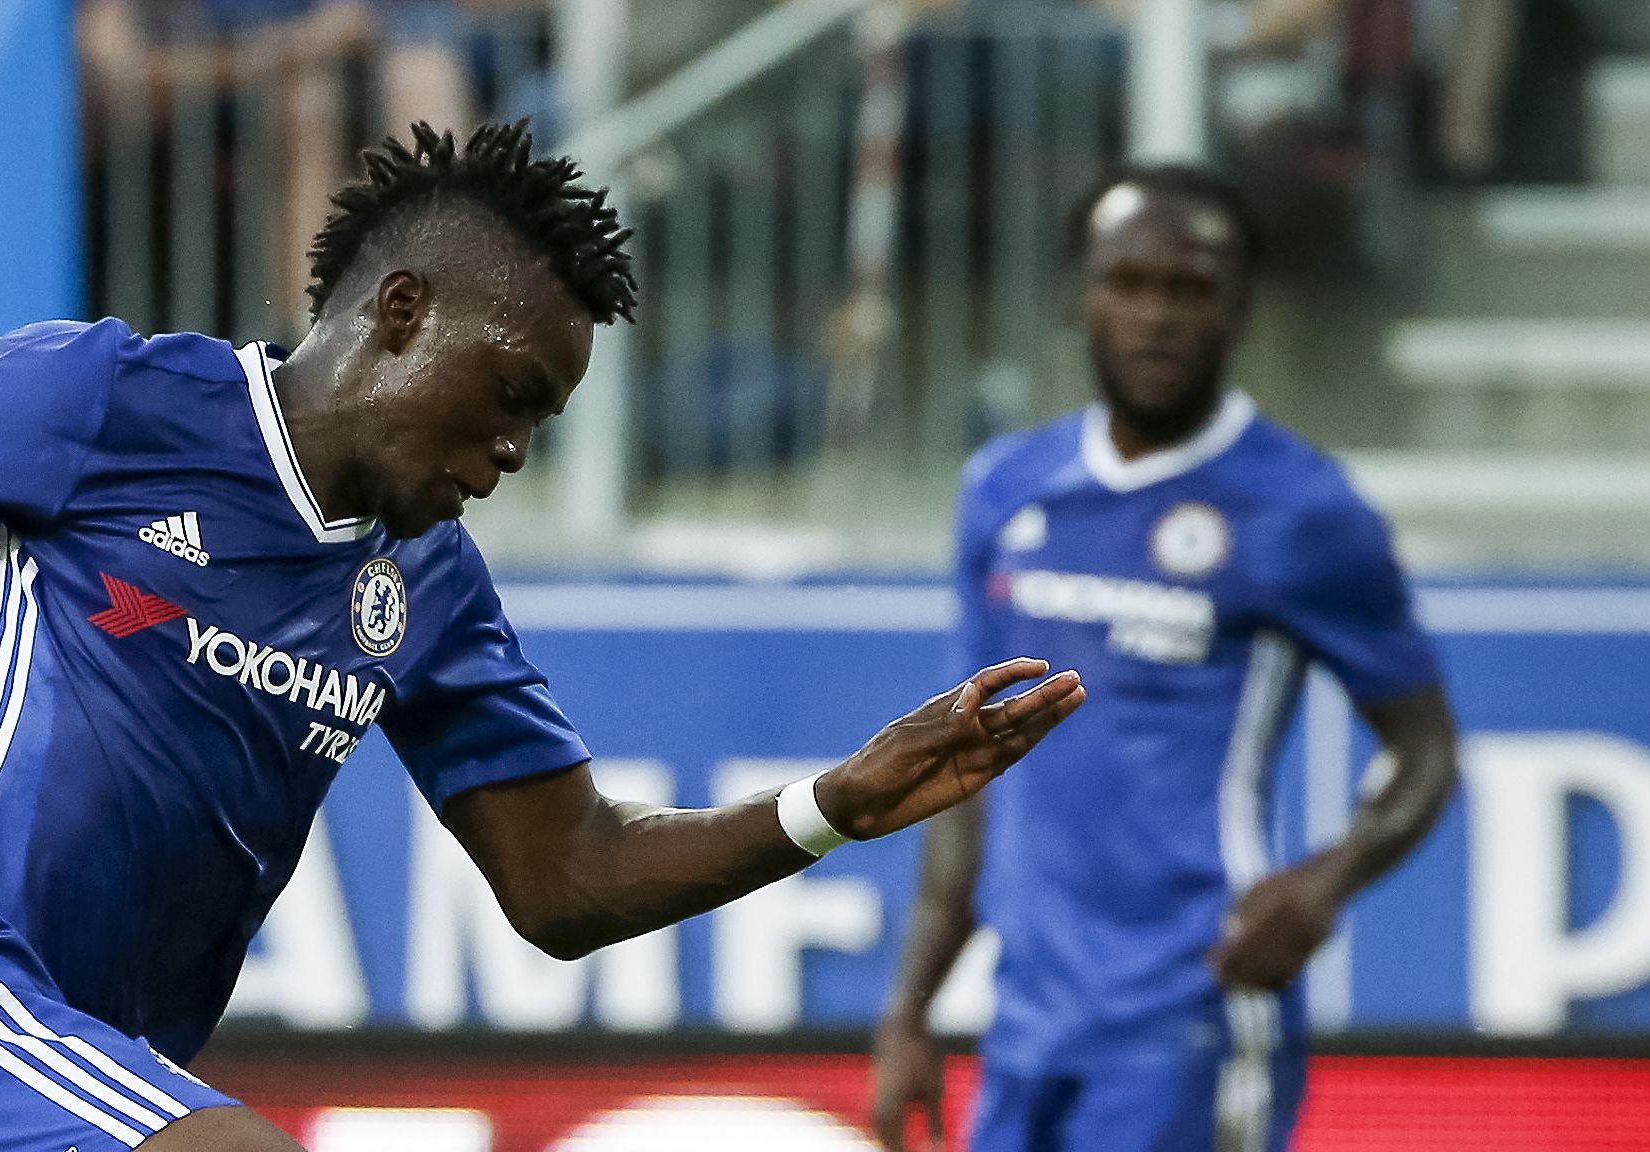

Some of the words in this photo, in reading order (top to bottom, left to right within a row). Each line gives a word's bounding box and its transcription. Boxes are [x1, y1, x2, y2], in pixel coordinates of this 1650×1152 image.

[138, 527, 211, 566] adidas
[186, 617, 386, 731] YOKOHAMA
[299, 721, 360, 764] TYR
